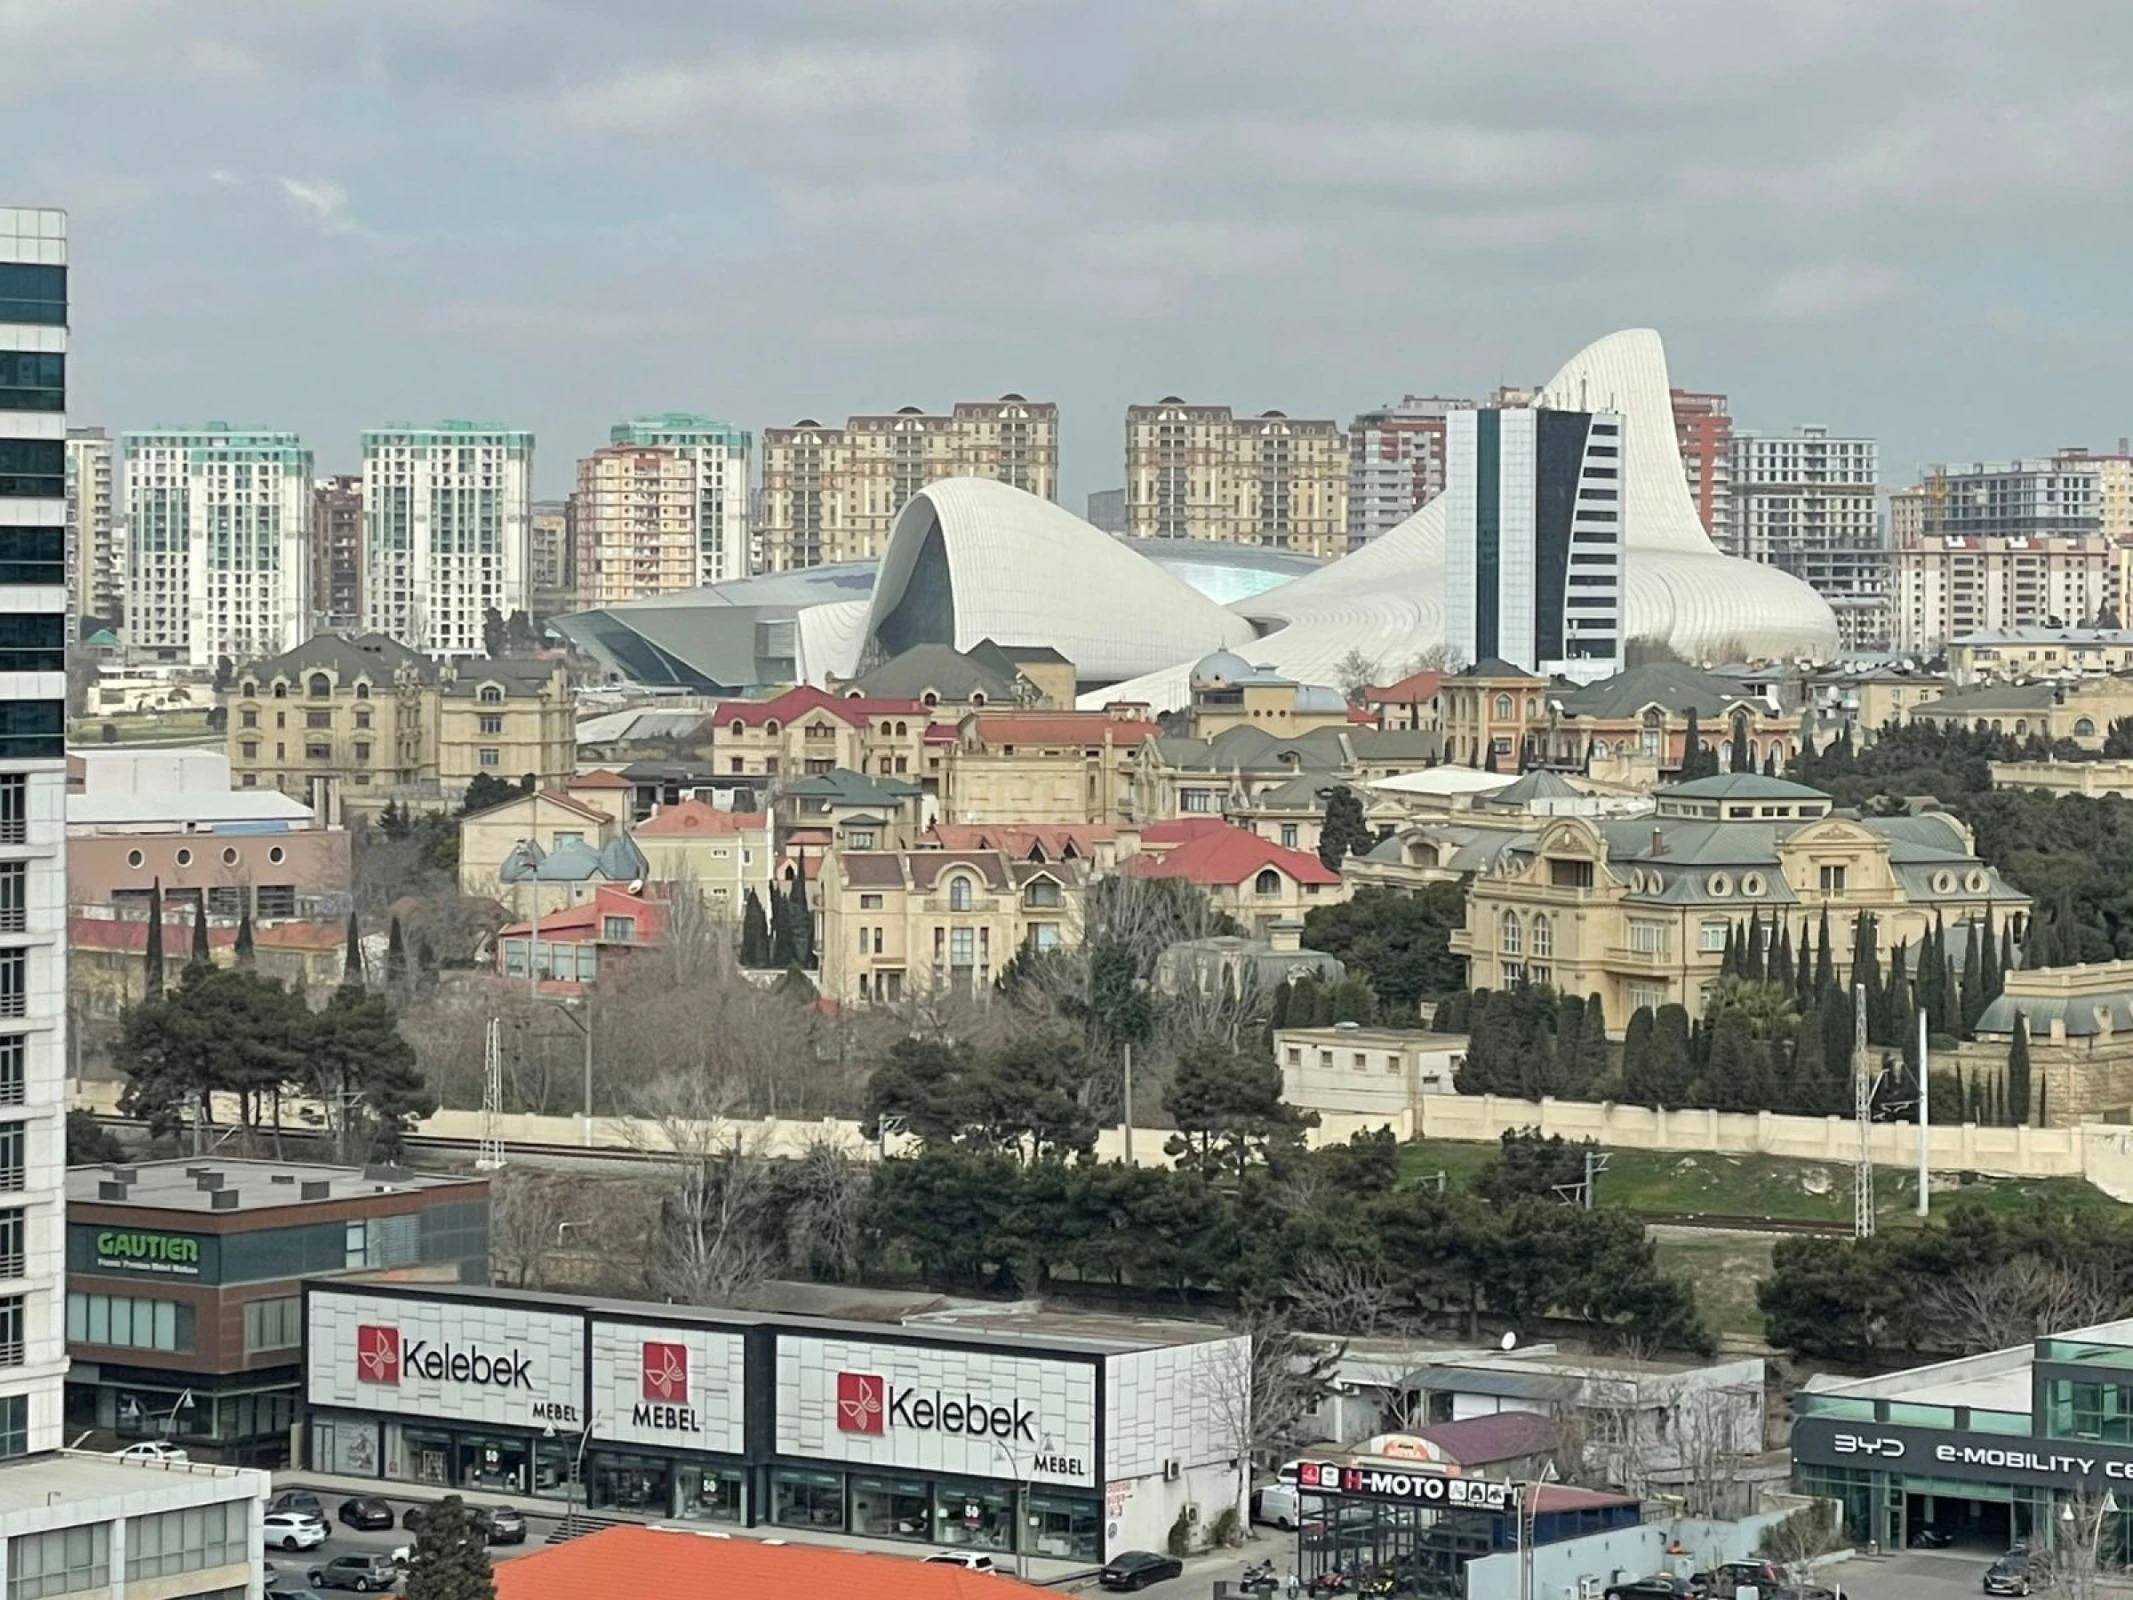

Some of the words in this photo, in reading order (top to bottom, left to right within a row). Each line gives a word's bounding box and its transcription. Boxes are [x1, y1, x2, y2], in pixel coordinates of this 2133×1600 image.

[97, 1231, 198, 1262] GAUTIER
[402, 1338, 533, 1390] Kelebek
[532, 1402, 578, 1422] MEBEL
[632, 1403, 700, 1432] MEBEL
[888, 1386, 1035, 1442] Kelebek
[1834, 1434, 1905, 1457] BYD
[1033, 1453, 1084, 1475] MEBEL
[1344, 1469, 1444, 1499] H-MOTO
